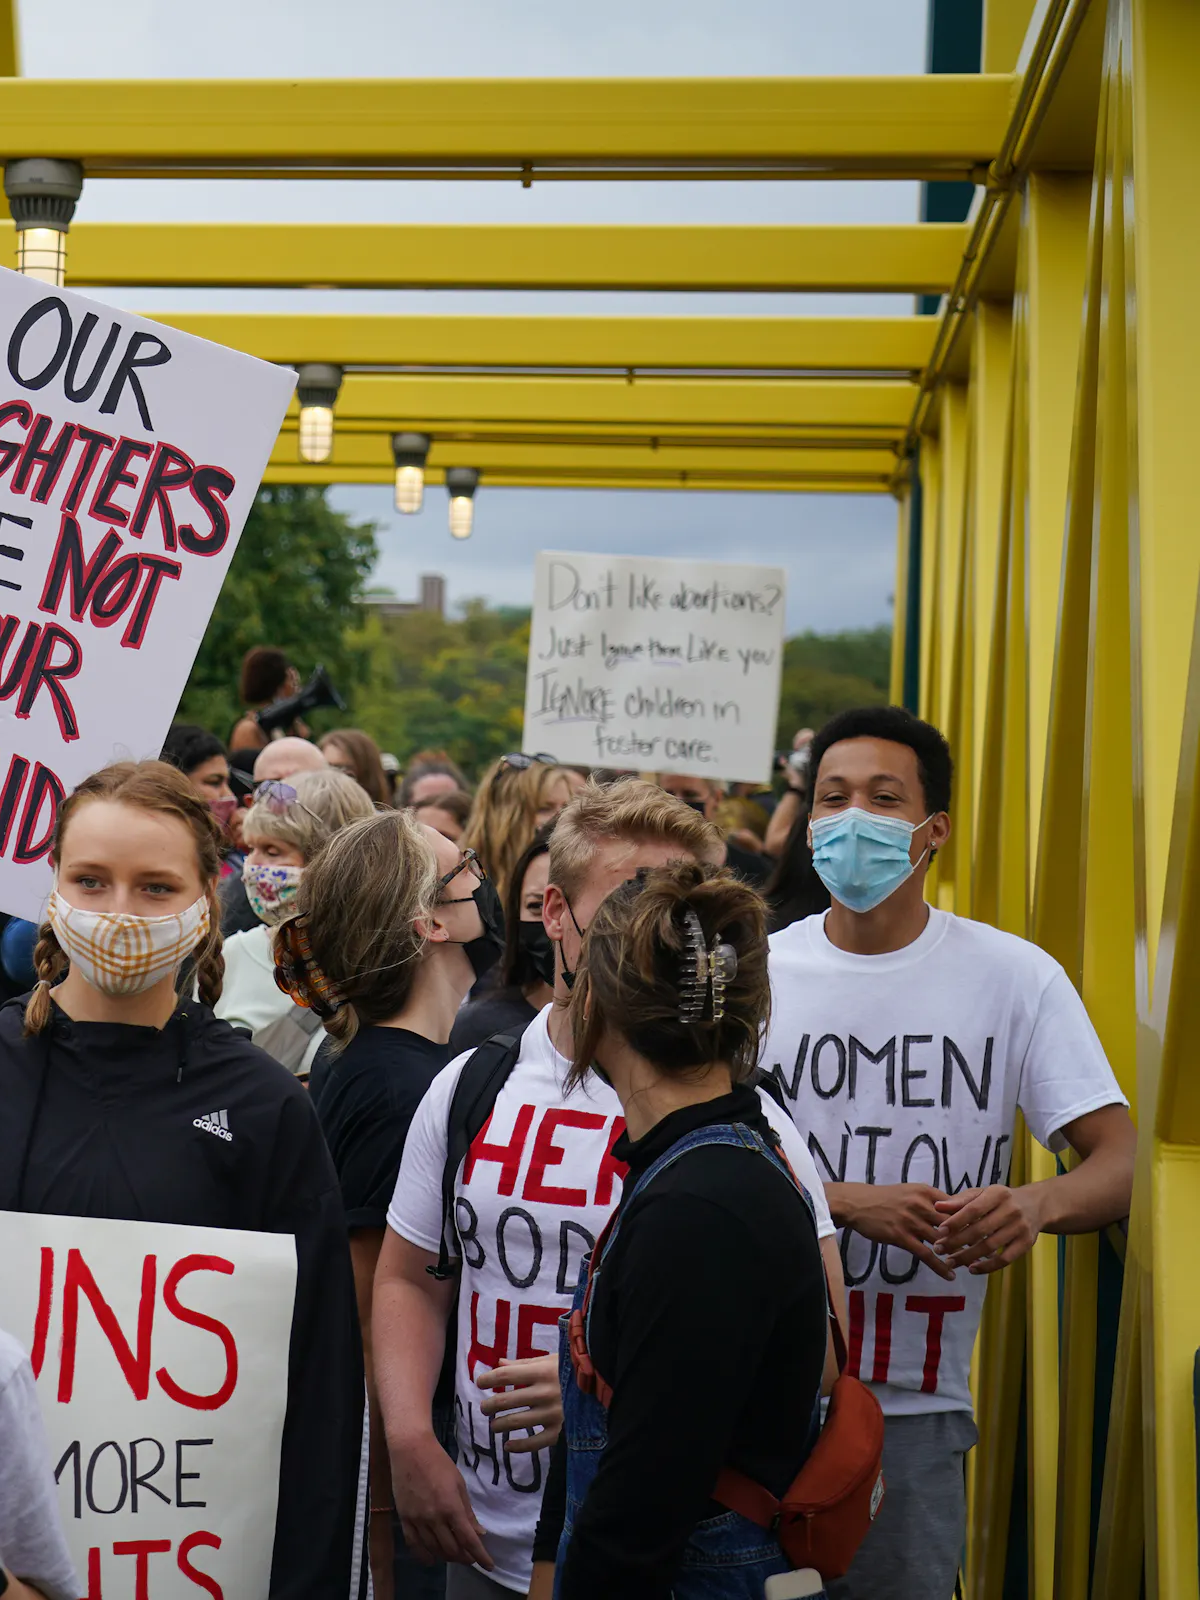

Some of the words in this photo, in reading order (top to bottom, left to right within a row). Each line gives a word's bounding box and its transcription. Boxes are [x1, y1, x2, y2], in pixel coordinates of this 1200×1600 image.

[7, 295, 172, 431] OUR
[37, 511, 182, 650] NOT
[547, 560, 618, 612] Don't
[628, 571, 663, 612] like
[669, 579, 782, 617] abortions?
[537, 625, 594, 661] Just
[737, 646, 775, 675] you
[624, 684, 704, 719] children
[712, 690, 741, 725] in
[593, 727, 661, 759] foster
[192, 1118, 233, 1142] adidas
